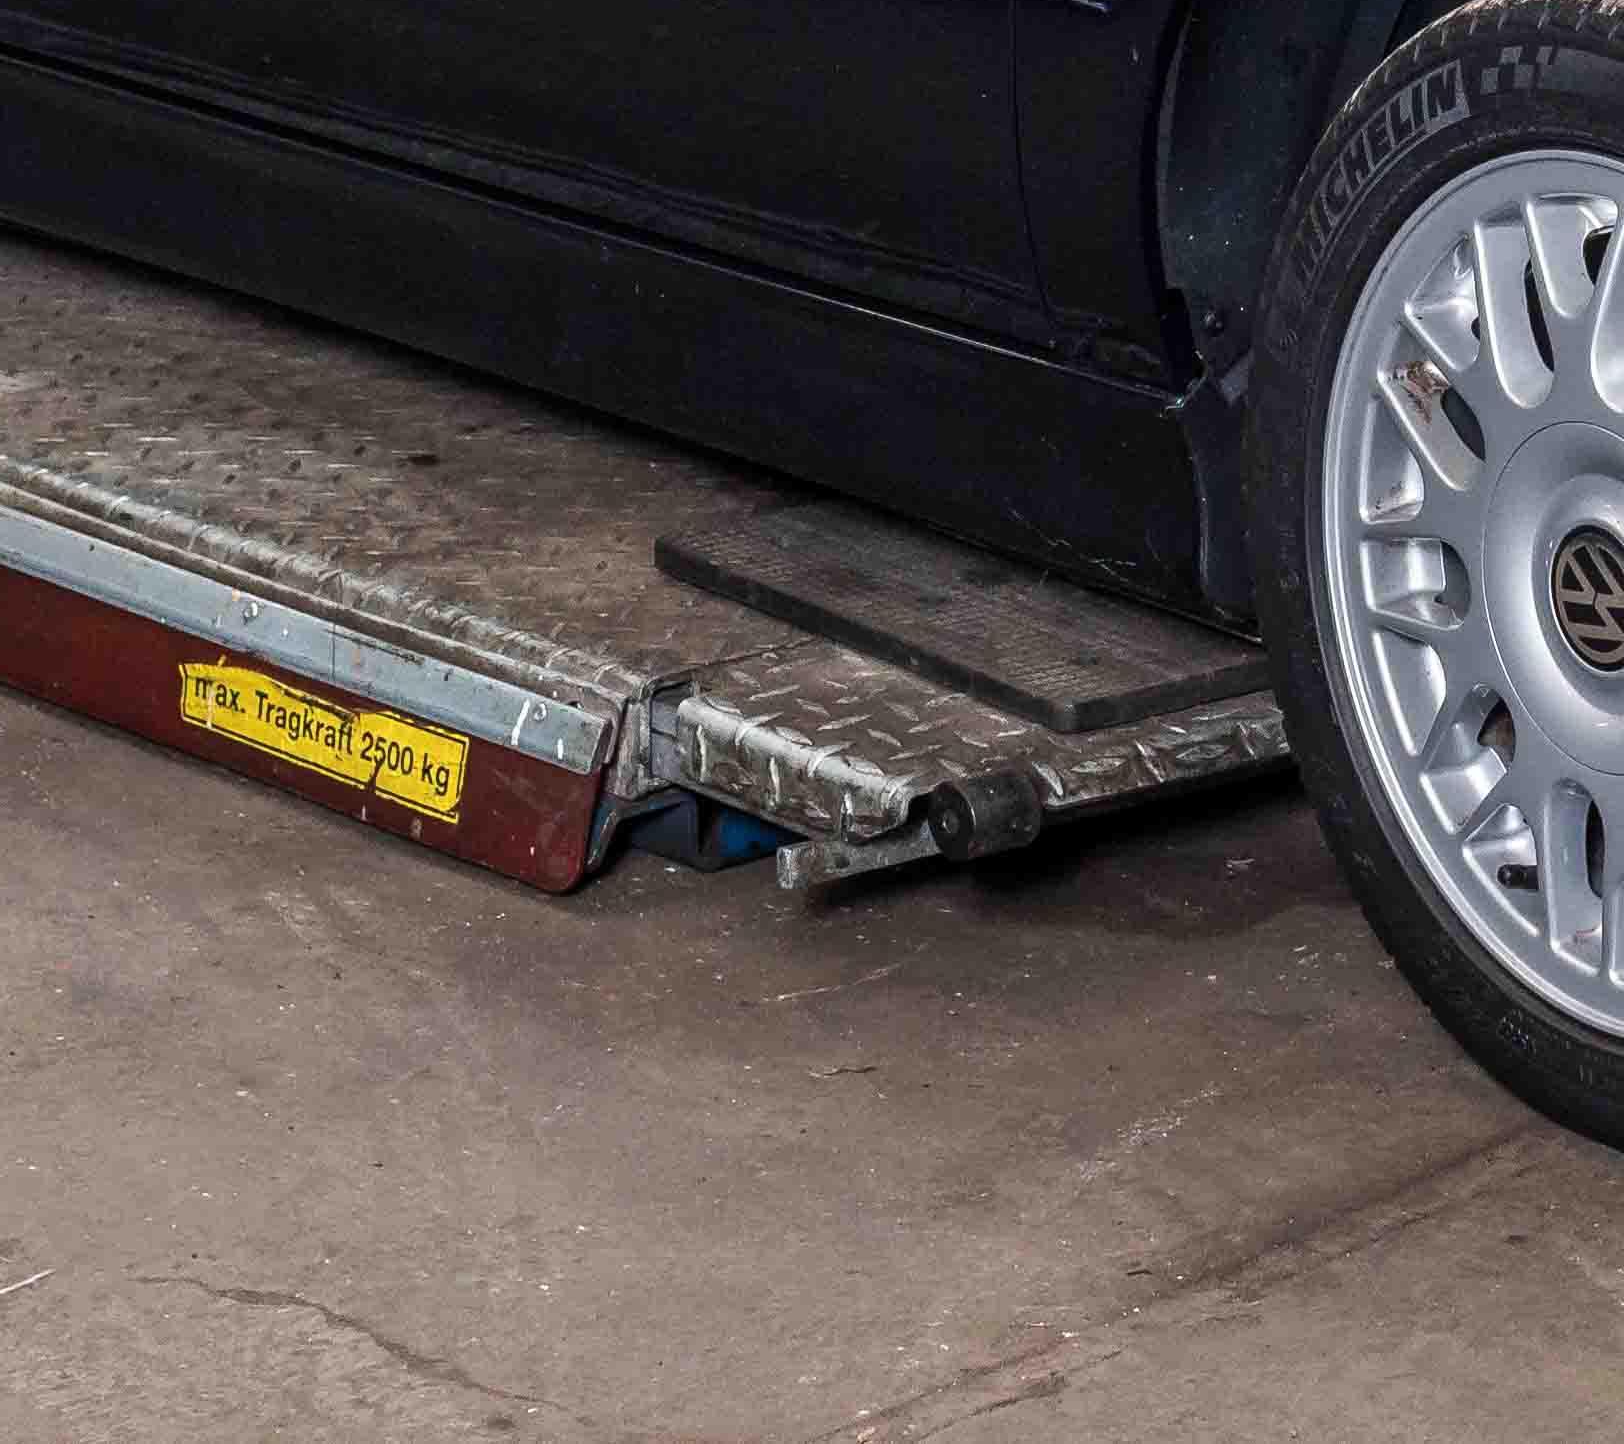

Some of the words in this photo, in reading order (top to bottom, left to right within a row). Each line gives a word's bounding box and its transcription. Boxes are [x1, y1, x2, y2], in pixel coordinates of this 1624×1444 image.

[1288, 63, 1466, 283] MICHELIN
[194, 677, 246, 714] max.
[255, 691, 353, 755] Tragkraft
[360, 731, 414, 776] 2500
[420, 750, 450, 796] kg
